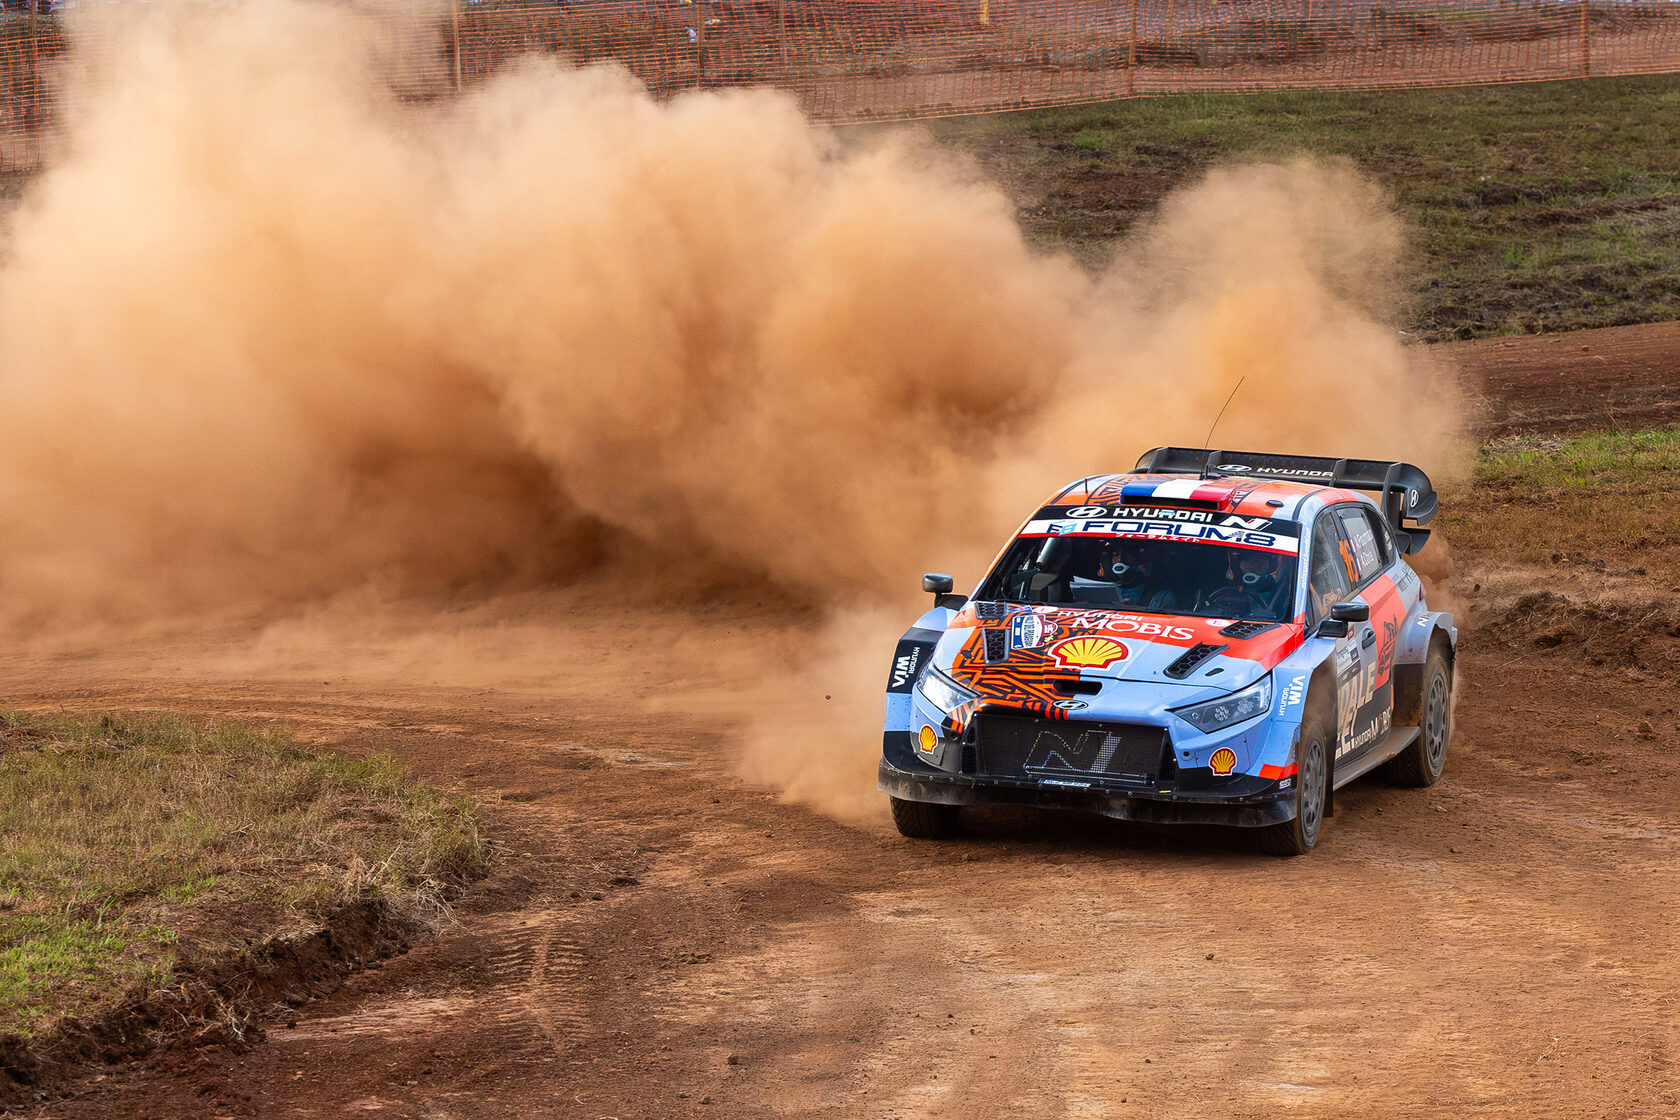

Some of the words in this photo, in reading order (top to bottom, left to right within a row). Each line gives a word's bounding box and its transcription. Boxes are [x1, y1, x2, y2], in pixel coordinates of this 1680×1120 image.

[1257, 466, 1334, 477] HYUNDA
[1112, 507, 1213, 523] HYUNDAI
[1082, 520, 1276, 547] FORUM8
[1339, 539, 1360, 583] 16
[1057, 610, 1144, 622] HYUNDAI
[1070, 617, 1195, 640] MOBIS
[907, 646, 920, 674] HYUNDAI
[1279, 687, 1290, 717] HYUNDAI
